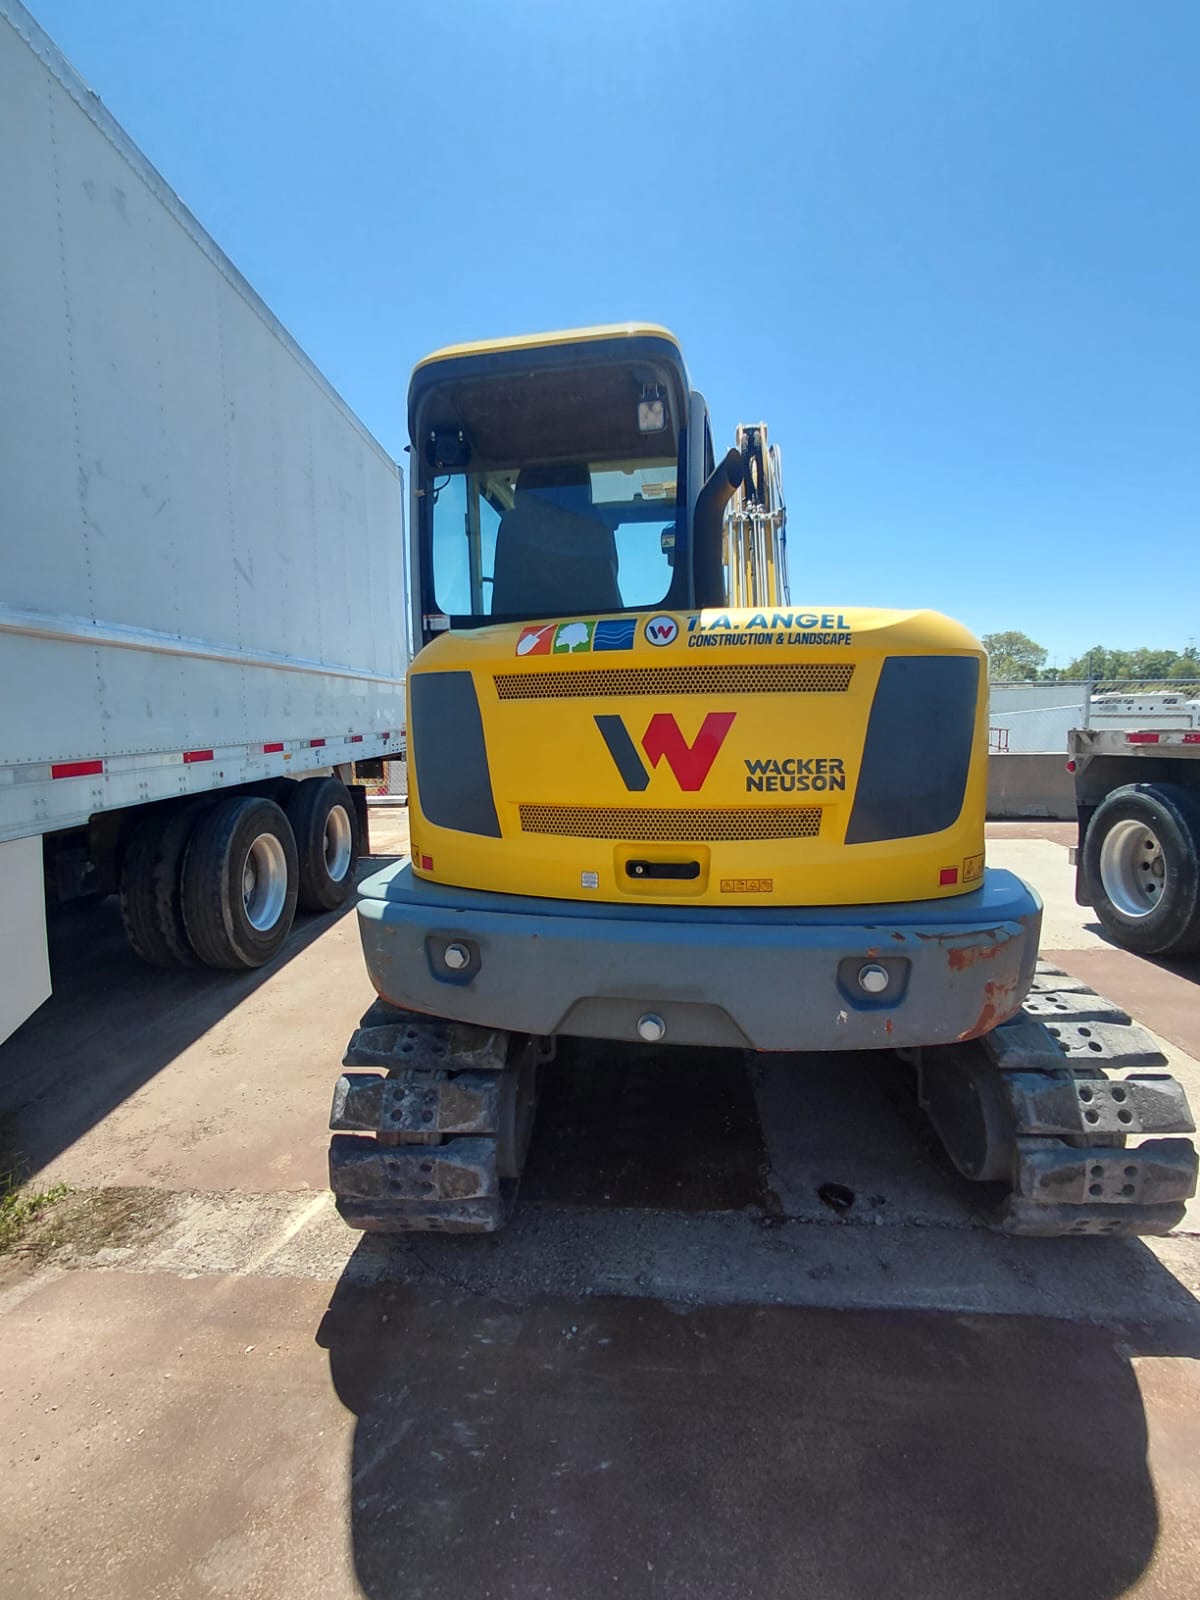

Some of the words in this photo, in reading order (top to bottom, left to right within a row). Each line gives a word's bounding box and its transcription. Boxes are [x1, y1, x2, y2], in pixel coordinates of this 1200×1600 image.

[745, 613, 851, 630] ANGEL
[688, 632, 773, 648] CONSTRUCTION
[776, 632, 785, 645] &
[788, 631, 851, 647] LANDSCAPE
[744, 758, 846, 775] WACKER
[746, 775, 846, 792] NEUSON
